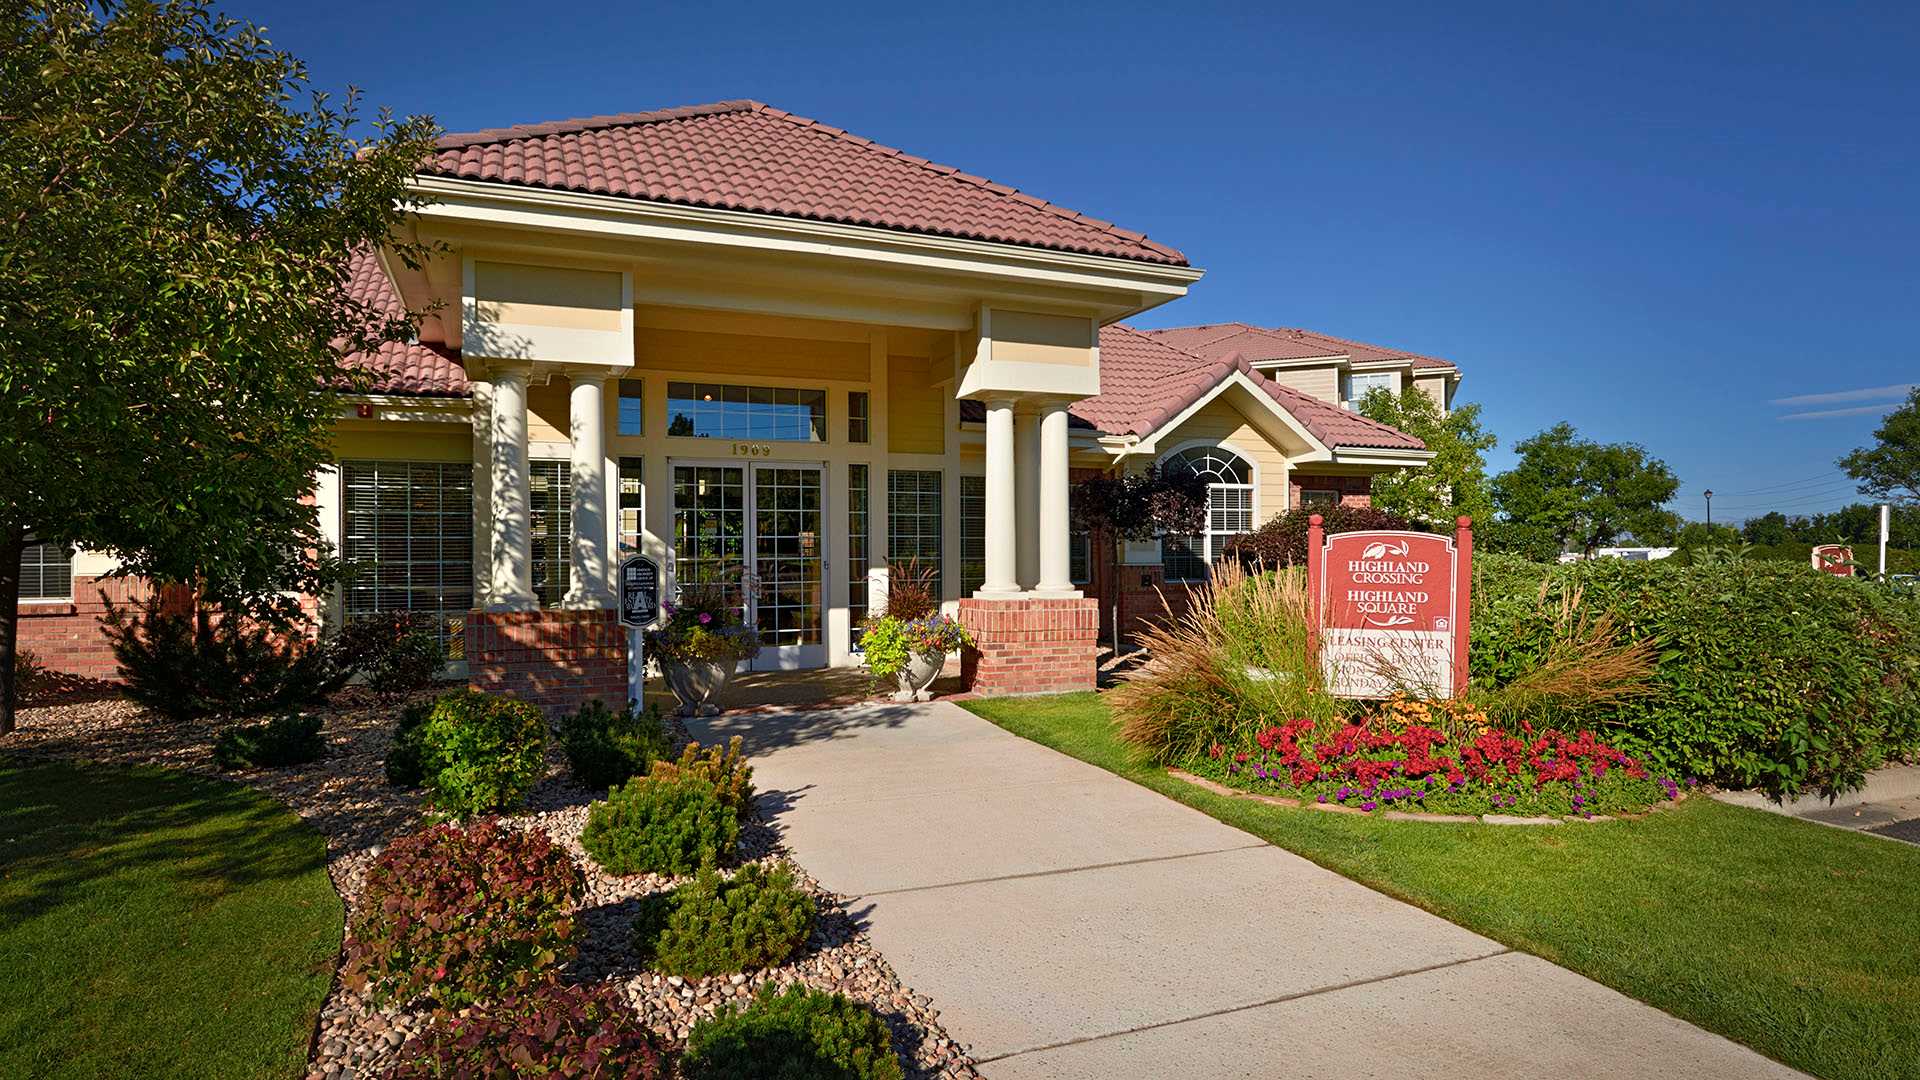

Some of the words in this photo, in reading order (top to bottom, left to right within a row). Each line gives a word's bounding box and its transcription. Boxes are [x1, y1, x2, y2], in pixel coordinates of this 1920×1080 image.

[1348, 560, 1430, 573] HIGHLAND
[1352, 573, 1423, 584] CROSSING
[1347, 590, 1429, 603] HIGHLAND
[1356, 602, 1417, 614] SQUARE
[1329, 636, 1387, 647] LEASING
[1335, 653, 1379, 664] OFFIC
